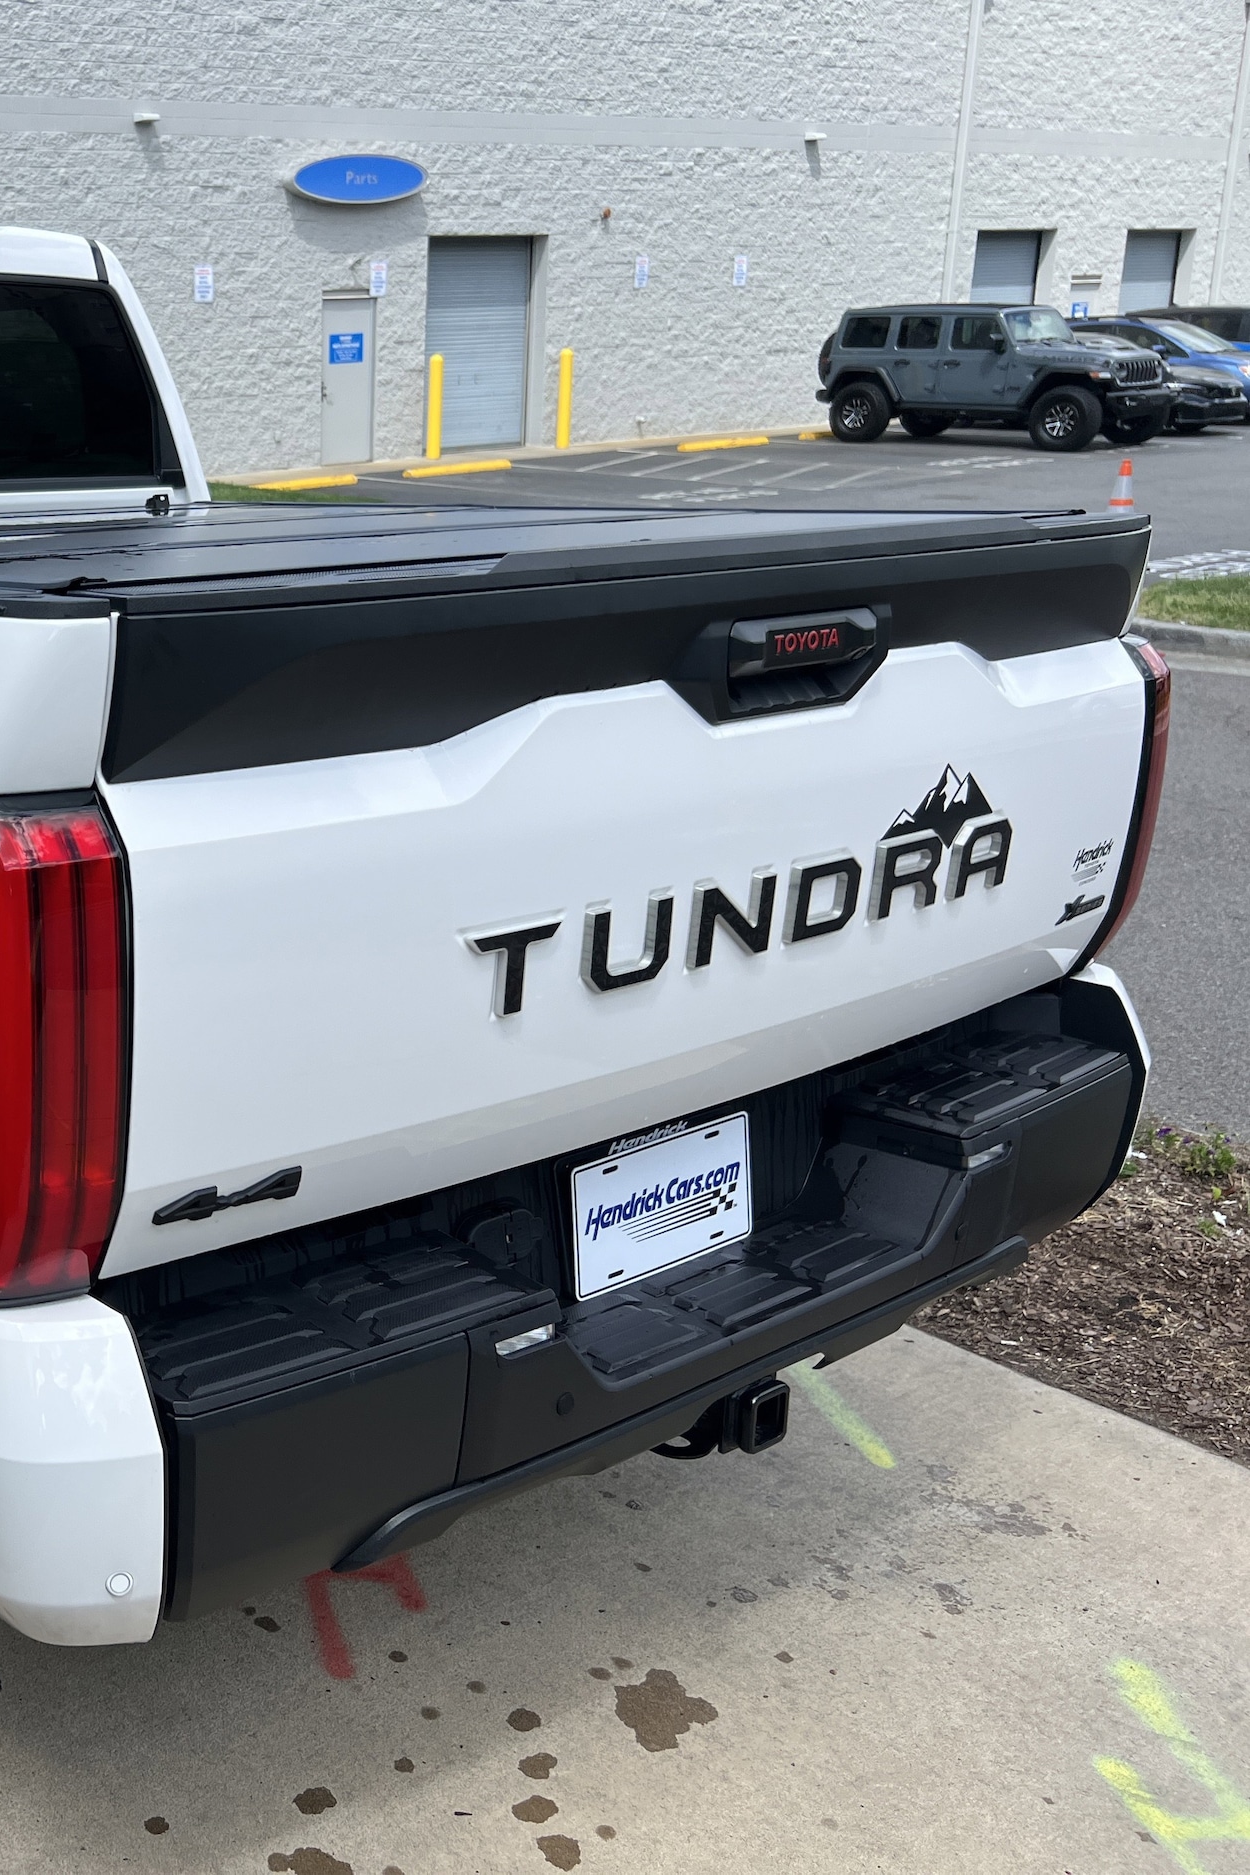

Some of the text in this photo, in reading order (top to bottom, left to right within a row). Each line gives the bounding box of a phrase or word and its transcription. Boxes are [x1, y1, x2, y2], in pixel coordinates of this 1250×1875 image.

[346, 170, 378, 185] Parts
[774, 627, 840, 655] TOYOTA
[1072, 838, 1114, 872] Hendrick
[459, 813, 1013, 1018] TUNDRA
[608, 1120, 689, 1155] Hendrick
